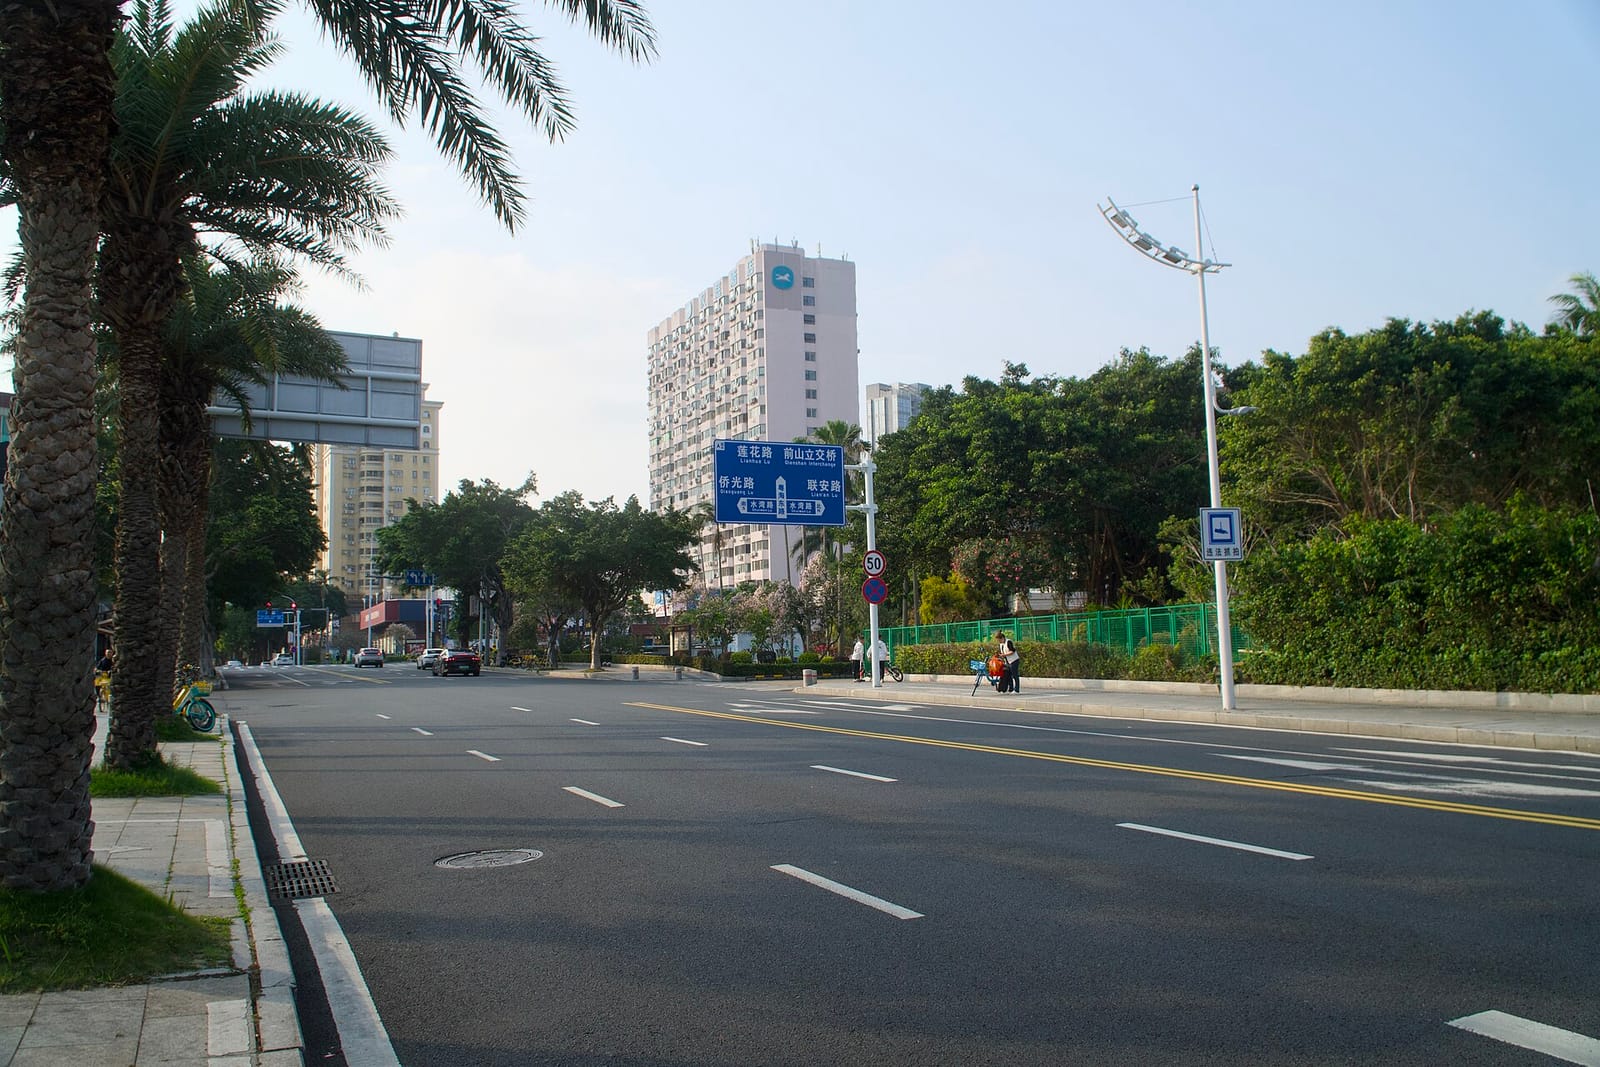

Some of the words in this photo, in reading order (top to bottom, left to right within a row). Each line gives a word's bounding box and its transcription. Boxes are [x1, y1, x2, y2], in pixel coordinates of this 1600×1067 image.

[737, 445, 772, 458] 莲花路
[784, 447, 837, 462] 前山立交桥
[719, 475, 754, 489] 侨光路
[807, 479, 841, 492] 联安路
[750, 500, 773, 509] 水湾路
[789, 501, 812, 510] 水湾路
[867, 557, 881, 570] 50
